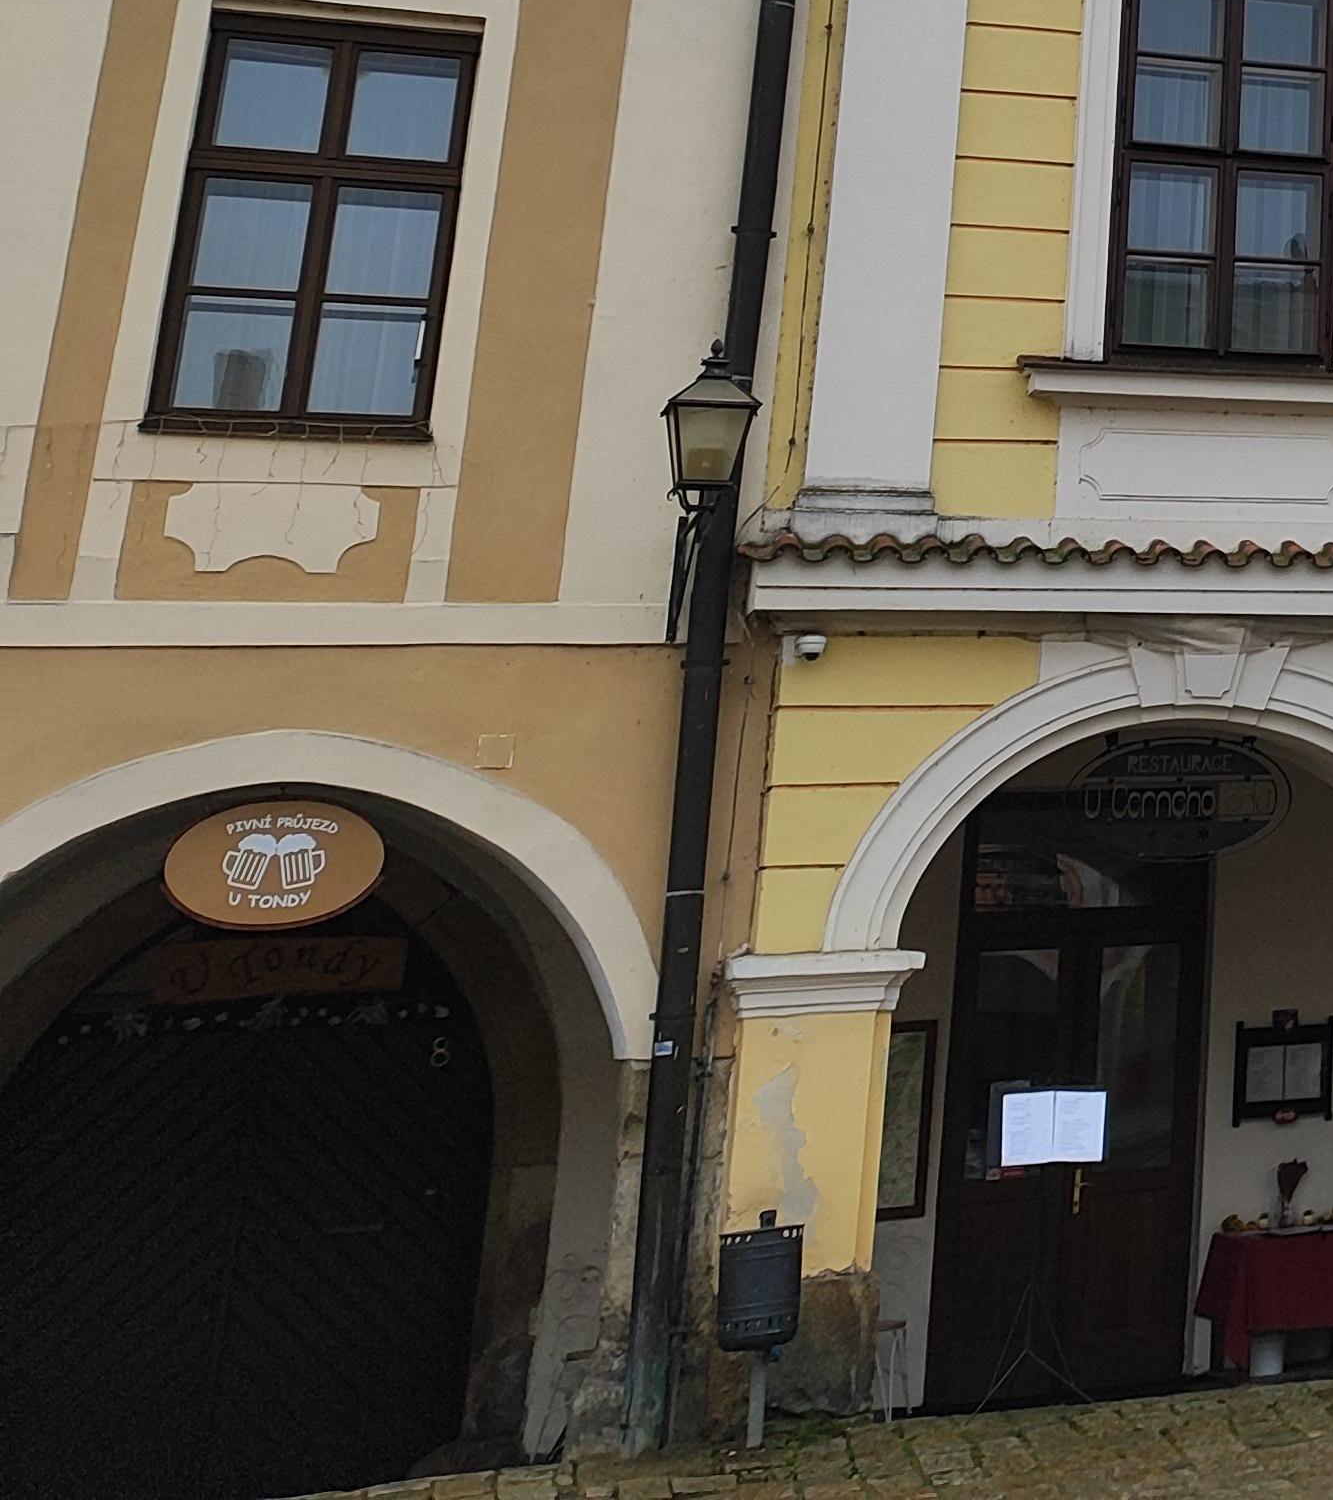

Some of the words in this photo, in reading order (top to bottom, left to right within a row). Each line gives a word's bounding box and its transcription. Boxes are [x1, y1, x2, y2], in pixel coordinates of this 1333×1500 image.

[1127, 755, 1232, 772] RESTAURACE
[226, 814, 272, 835] PIVNÍ
[276, 813, 339, 834] PRŮJEZD
[228, 889, 241, 906] U
[247, 889, 311, 908] TONDY
[432, 1037, 450, 1067] 8
